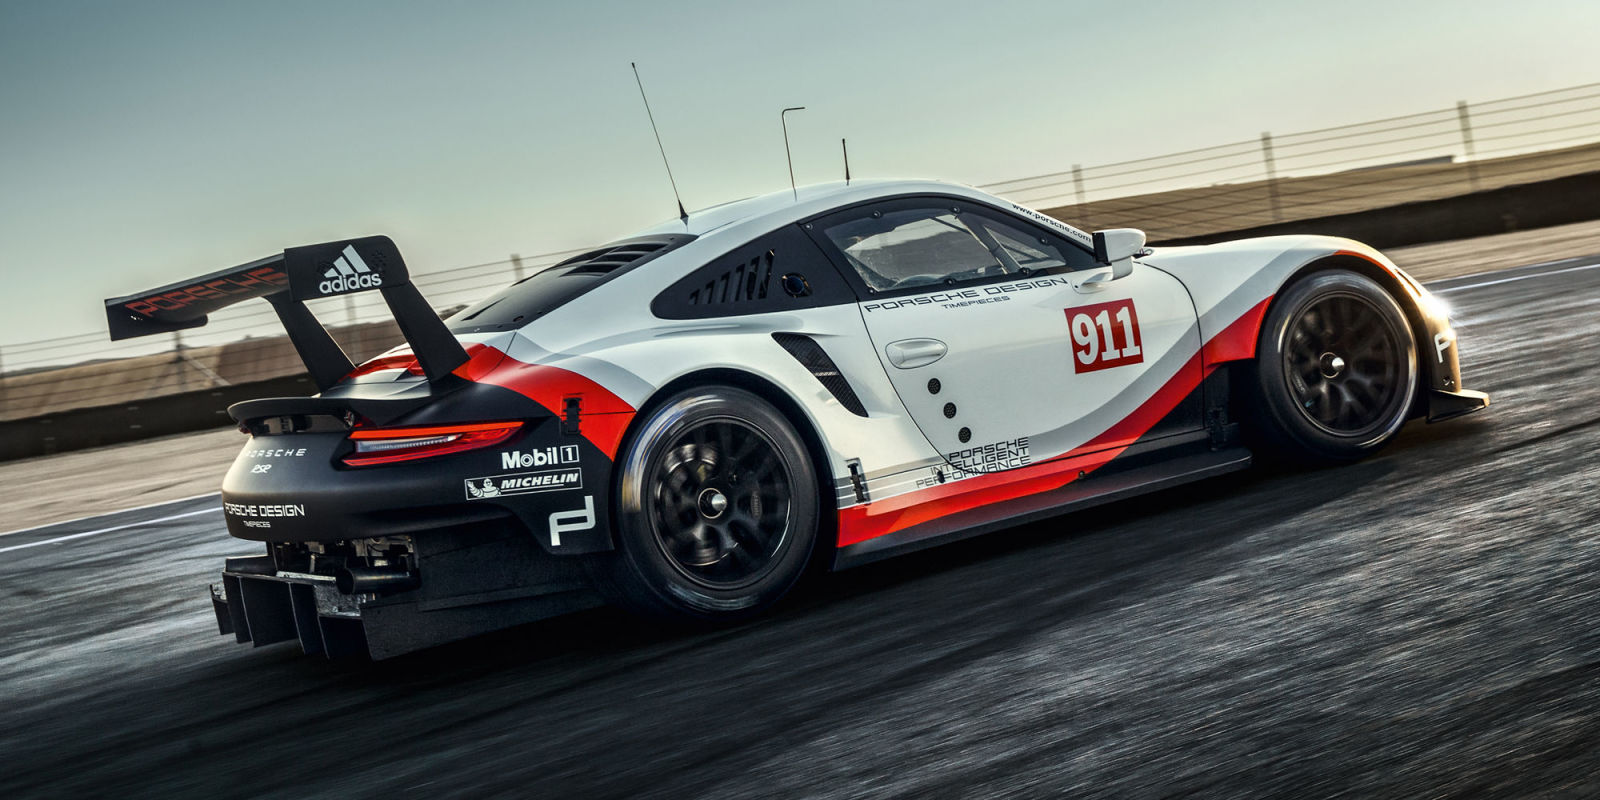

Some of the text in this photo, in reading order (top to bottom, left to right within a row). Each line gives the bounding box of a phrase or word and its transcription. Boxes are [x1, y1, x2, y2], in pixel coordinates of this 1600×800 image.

[1012, 203, 1092, 243] www.porsche.com
[318, 273, 383, 294] adidas
[863, 277, 1068, 313] PORSCHE DESIGN
[942, 295, 1011, 310] TIMEPIECES
[1071, 306, 1141, 365] 911
[501, 446, 559, 470] Mobil
[930, 446, 1030, 474] INTELLIGENT
[948, 436, 1029, 462] PORSCHE
[500, 473, 579, 490] MICHELIN
[916, 455, 1032, 489] PERFORMANCE
[224, 502, 305, 517] PORSCHE DESIGN
